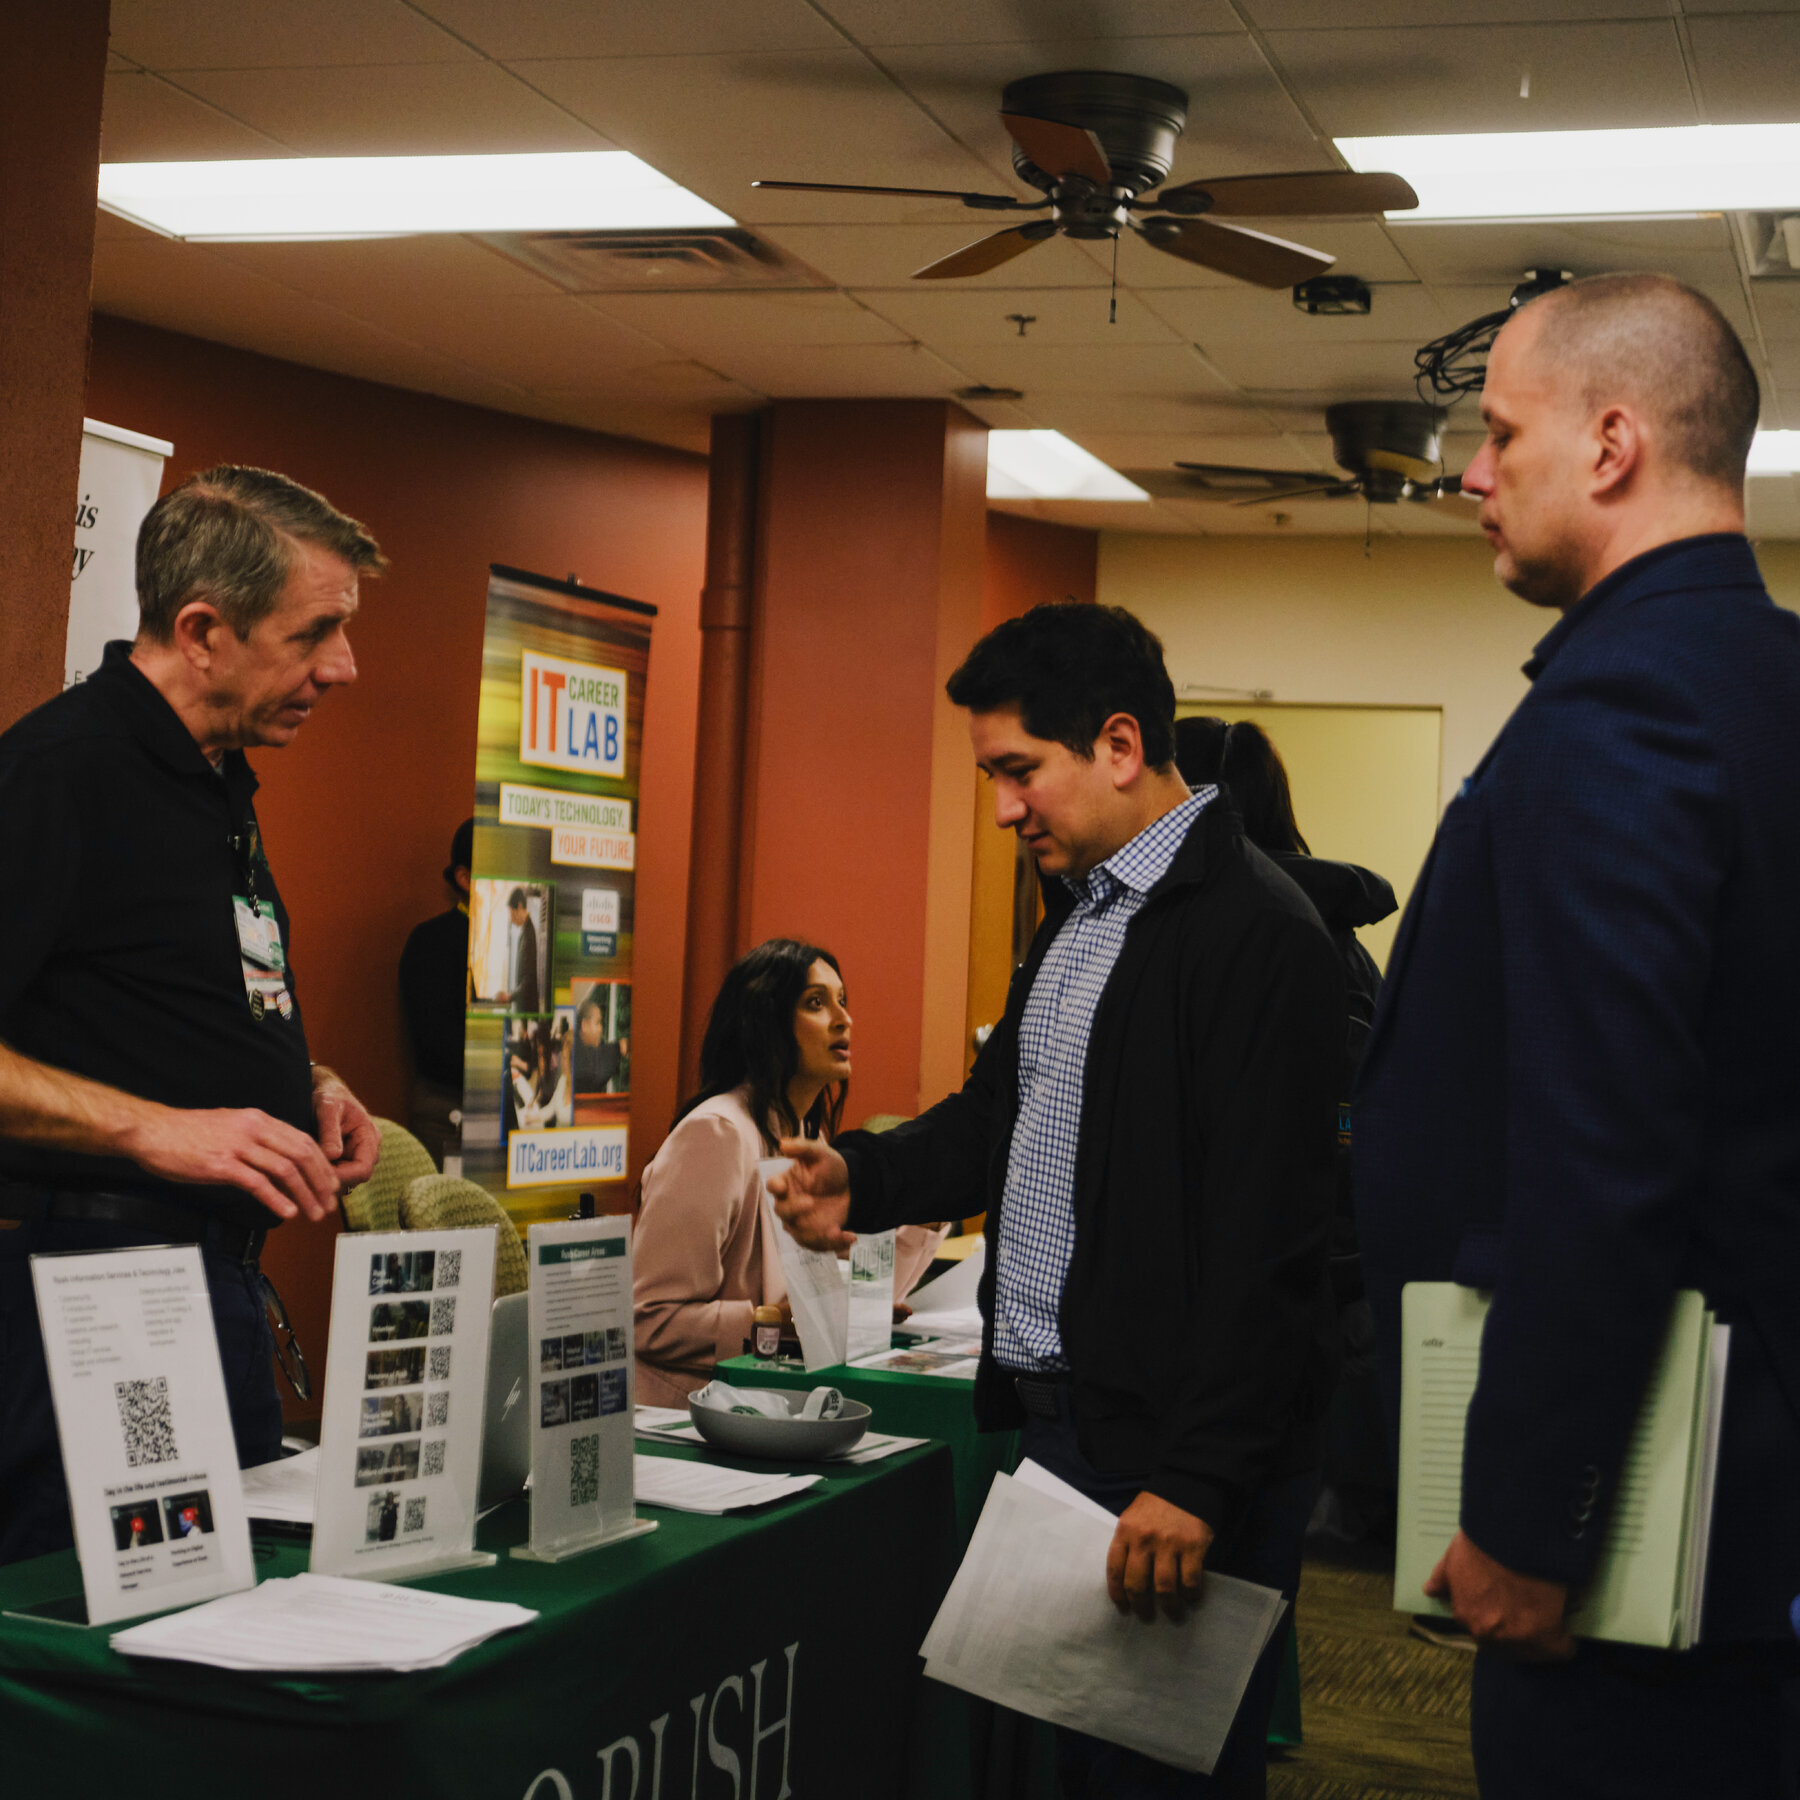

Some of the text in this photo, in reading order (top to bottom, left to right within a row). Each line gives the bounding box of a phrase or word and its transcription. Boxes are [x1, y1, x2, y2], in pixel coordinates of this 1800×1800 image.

[73, 547, 95, 581] y
[568, 675, 619, 708] CAREER
[529, 667, 566, 753] IT
[568, 707, 618, 762] LAB
[508, 793, 625, 828] TODAY'S TECHNOLOGY.
[557, 833, 632, 862] YOUR FUTURE.
[515, 1140, 622, 1173] ITCareerLab.org
